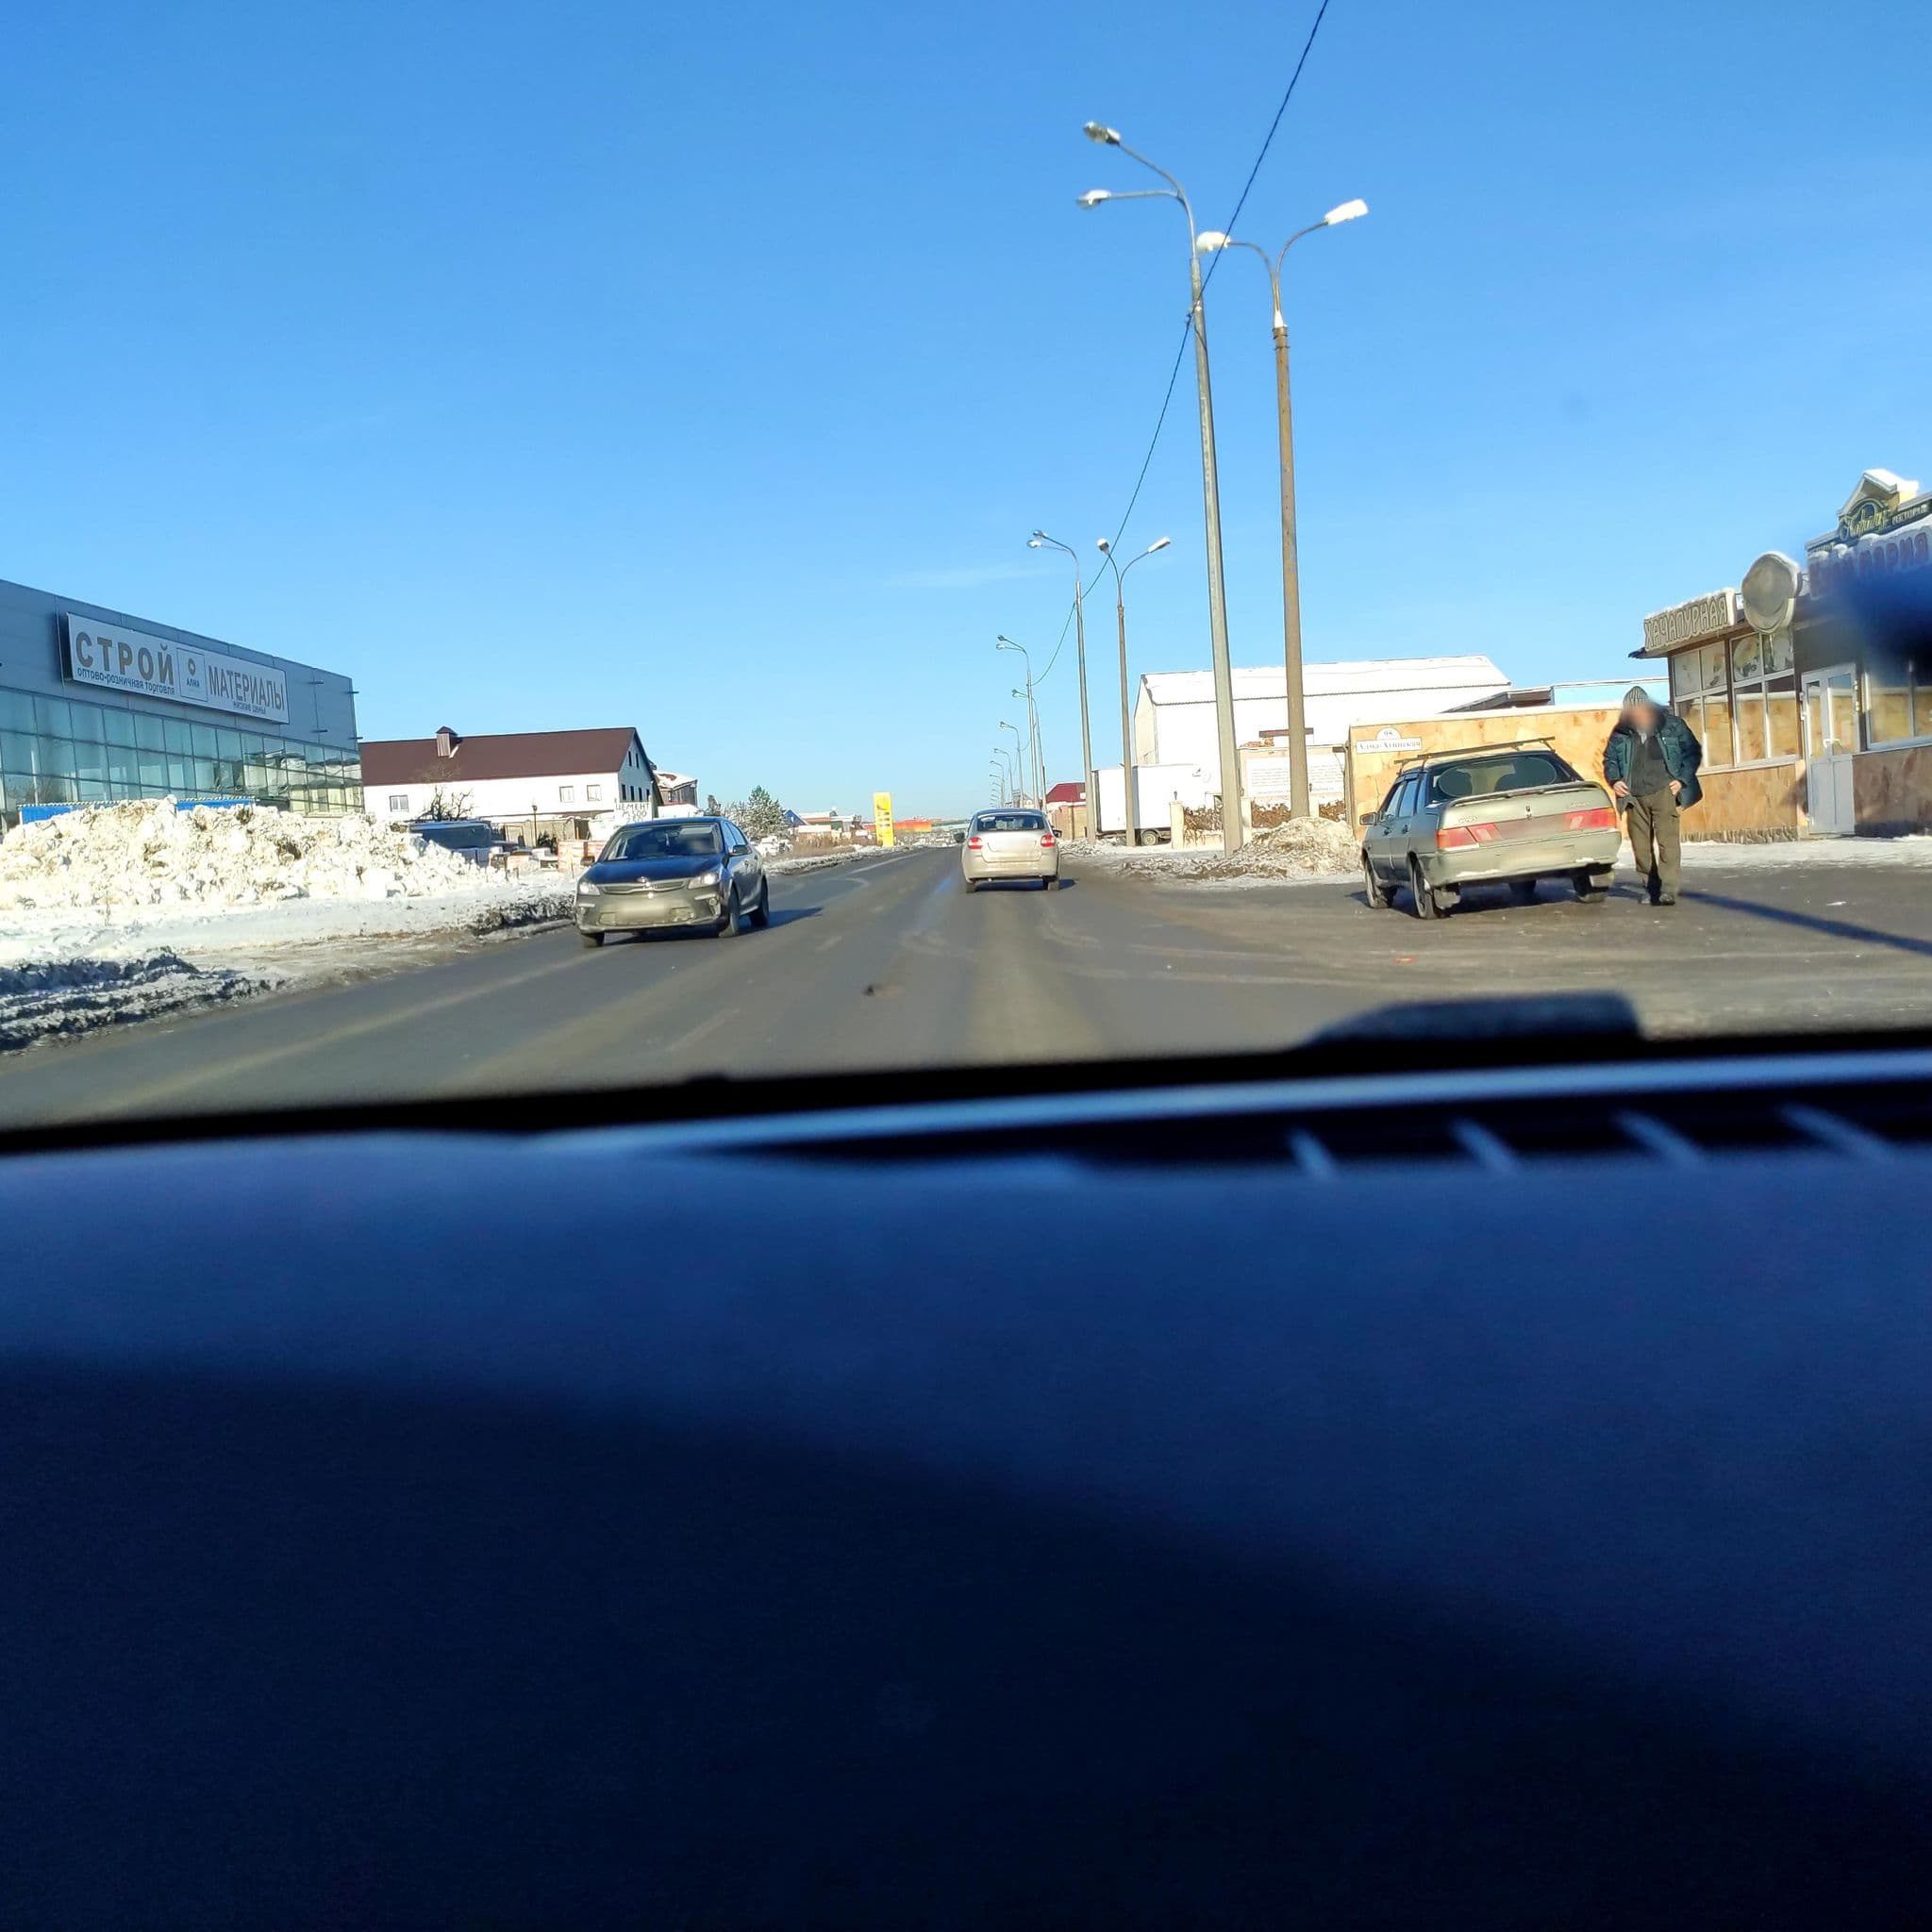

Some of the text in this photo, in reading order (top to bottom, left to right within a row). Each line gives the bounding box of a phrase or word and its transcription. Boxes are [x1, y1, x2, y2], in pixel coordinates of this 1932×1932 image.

[1644, 595, 1727, 650] ХАЧАПУРНАЯ
[75, 631, 285, 711] СТРОЙ МАТЕРИАЛЫ
[144, 681, 175, 695] торговля
